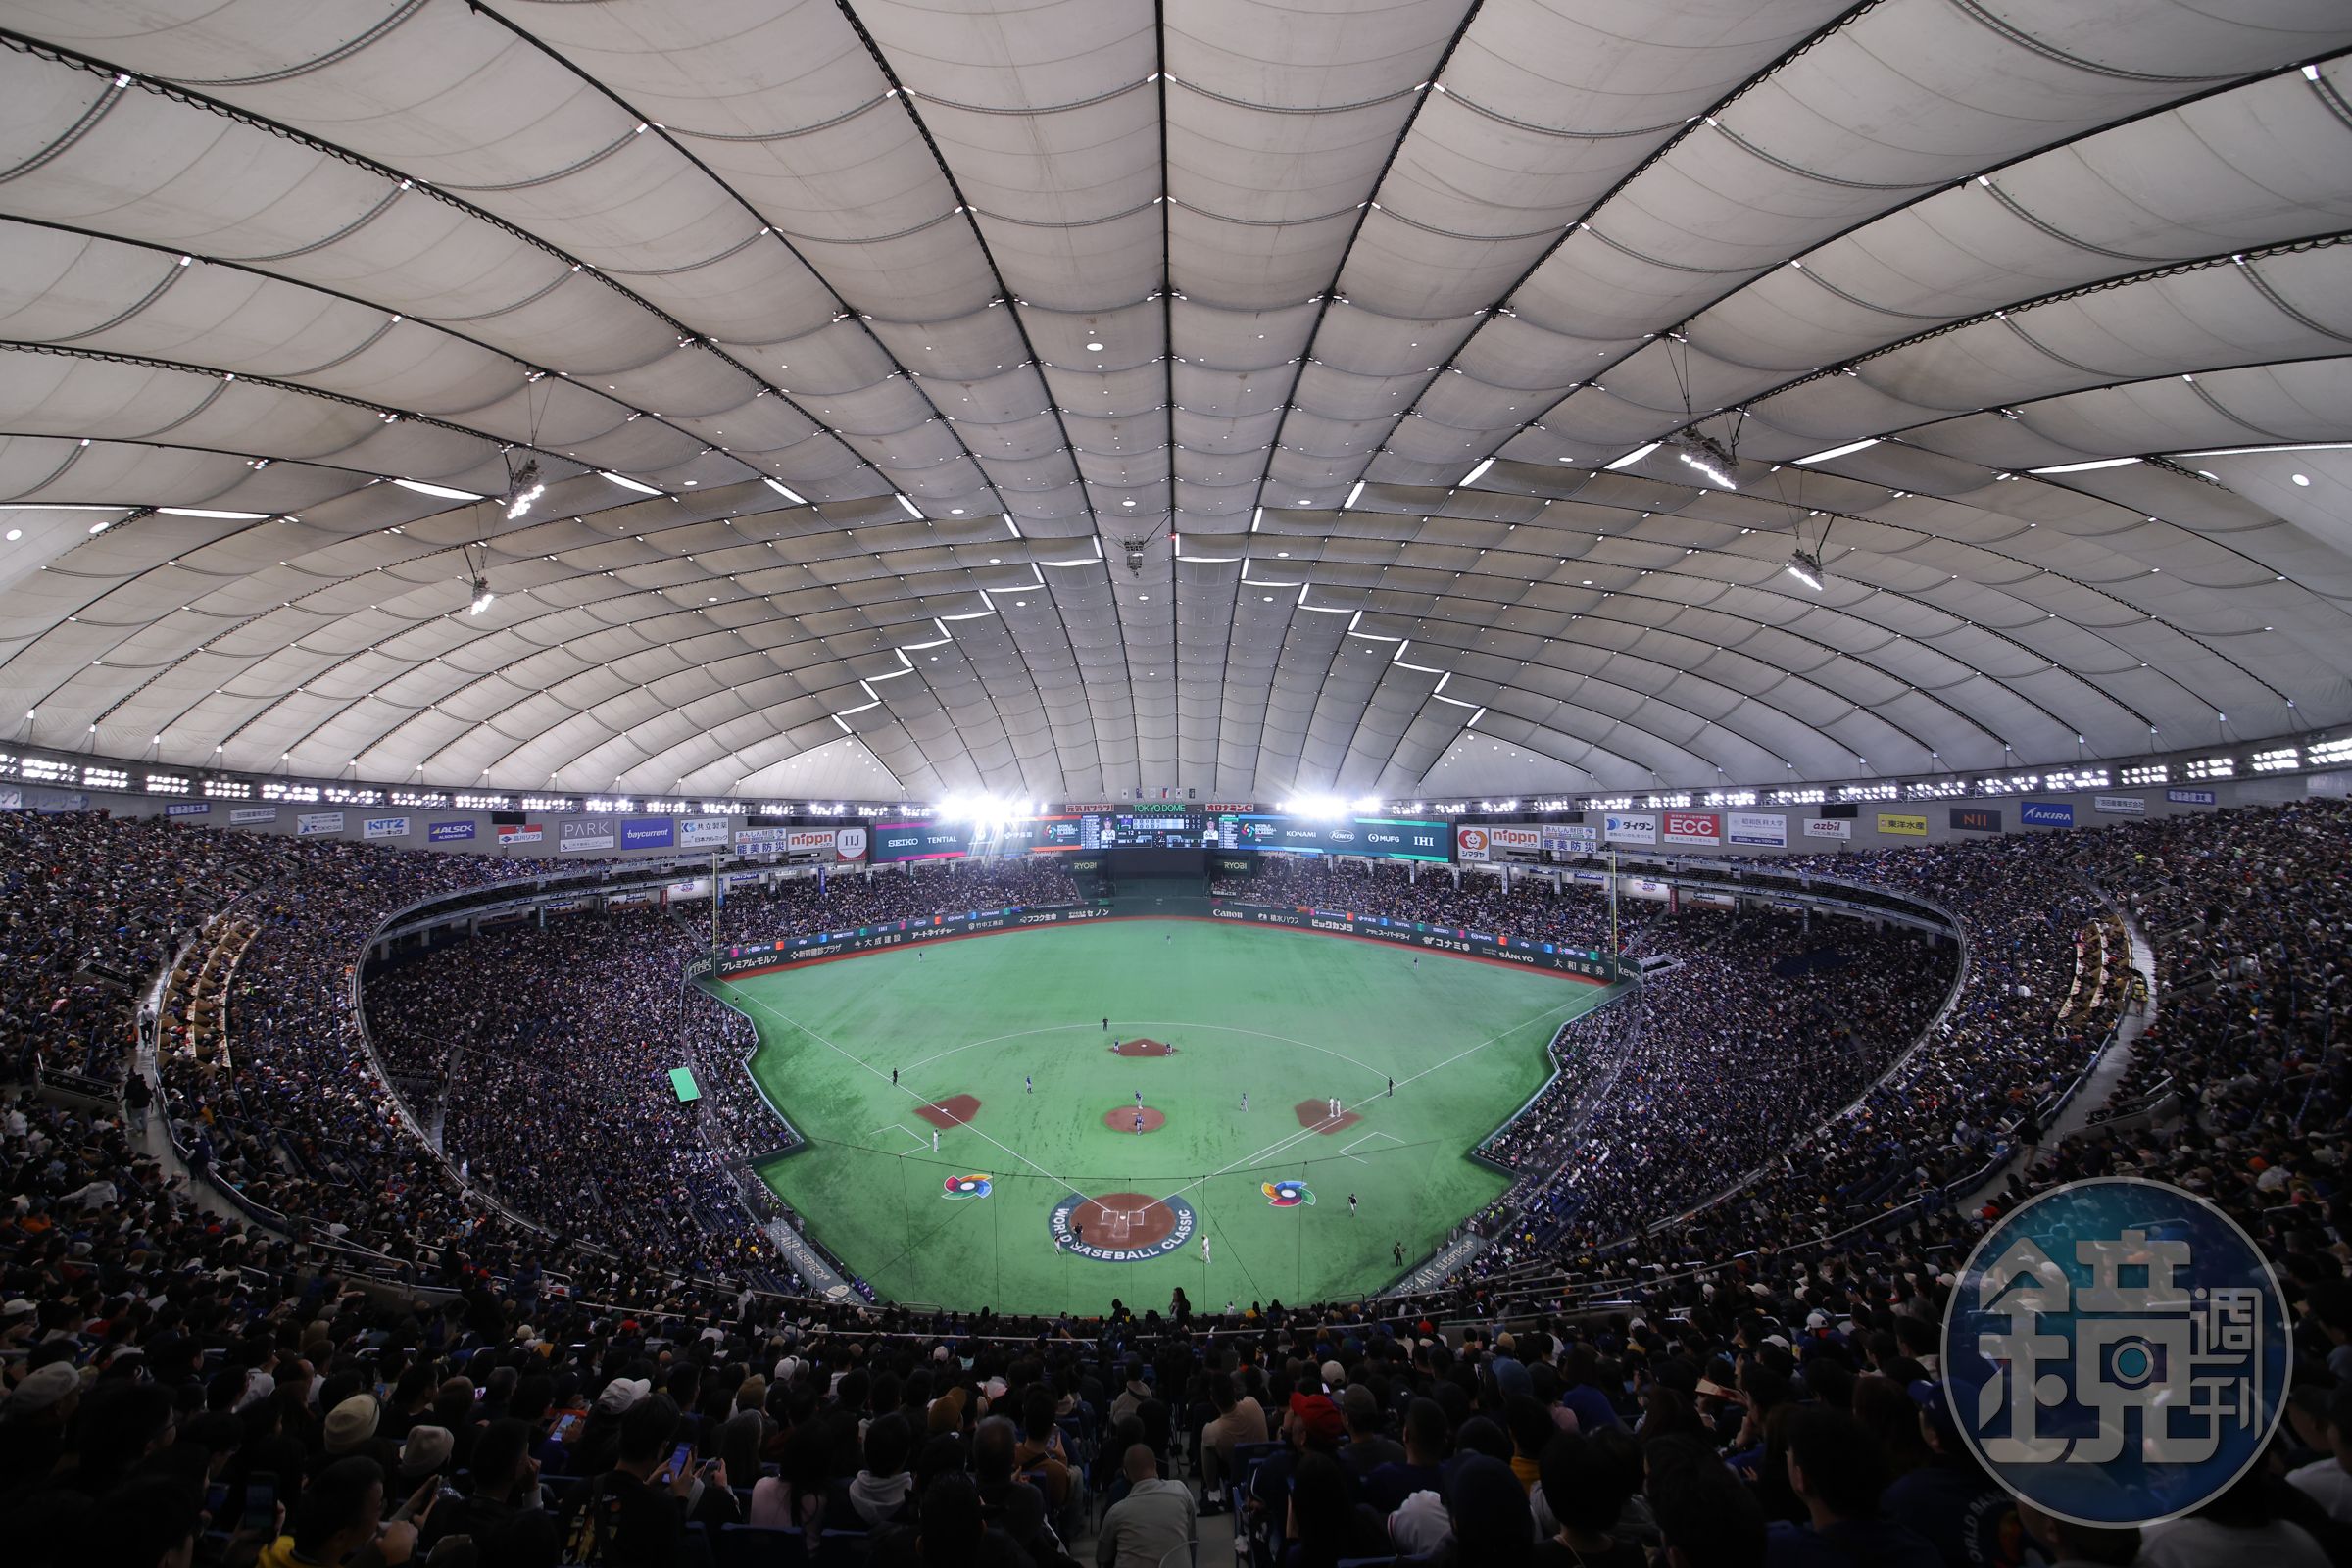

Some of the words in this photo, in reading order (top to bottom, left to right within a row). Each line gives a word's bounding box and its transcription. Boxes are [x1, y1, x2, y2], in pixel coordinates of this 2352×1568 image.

[1133, 804, 1161, 812] TOKYO
[1161, 804, 1186, 812] DOME
[1206, 804, 1252, 812] オロナミンC
[440, 824, 473, 834] ALSOK
[564, 821, 610, 838] PARK
[1622, 821, 1654, 831] ダイダン
[1669, 819, 1713, 835] ECC
[1813, 821, 1840, 831] azbil
[627, 828, 669, 840] baycurrent
[791, 833, 833, 847] nippn
[927, 836, 957, 845] TENTIAL
[1494, 829, 1538, 844] nippn
[845, 835, 859, 847] IIJ
[888, 837, 919, 848] SEIKO
[1413, 836, 1434, 847] IHI
[1544, 839, 1595, 853] 能美防災
[736, 841, 785, 855] 能美防災
[1212, 908, 1243, 919] Canon
[1270, 914, 1300, 925] 積水ハウス
[1311, 918, 1353, 932] ビックカメラ
[864, 933, 902, 947] 大成建設
[1498, 950, 1534, 963] SANKYO
[1553, 958, 1606, 976] 大和証券
[1053, 1207, 1073, 1243] WORLD
[1069, 1239, 1160, 1261] BASEBALL
[1161, 1208, 1193, 1250] CLASSIC
[780, 1235, 801, 1250] AIR
[1415, 1268, 1441, 1288] AIR
